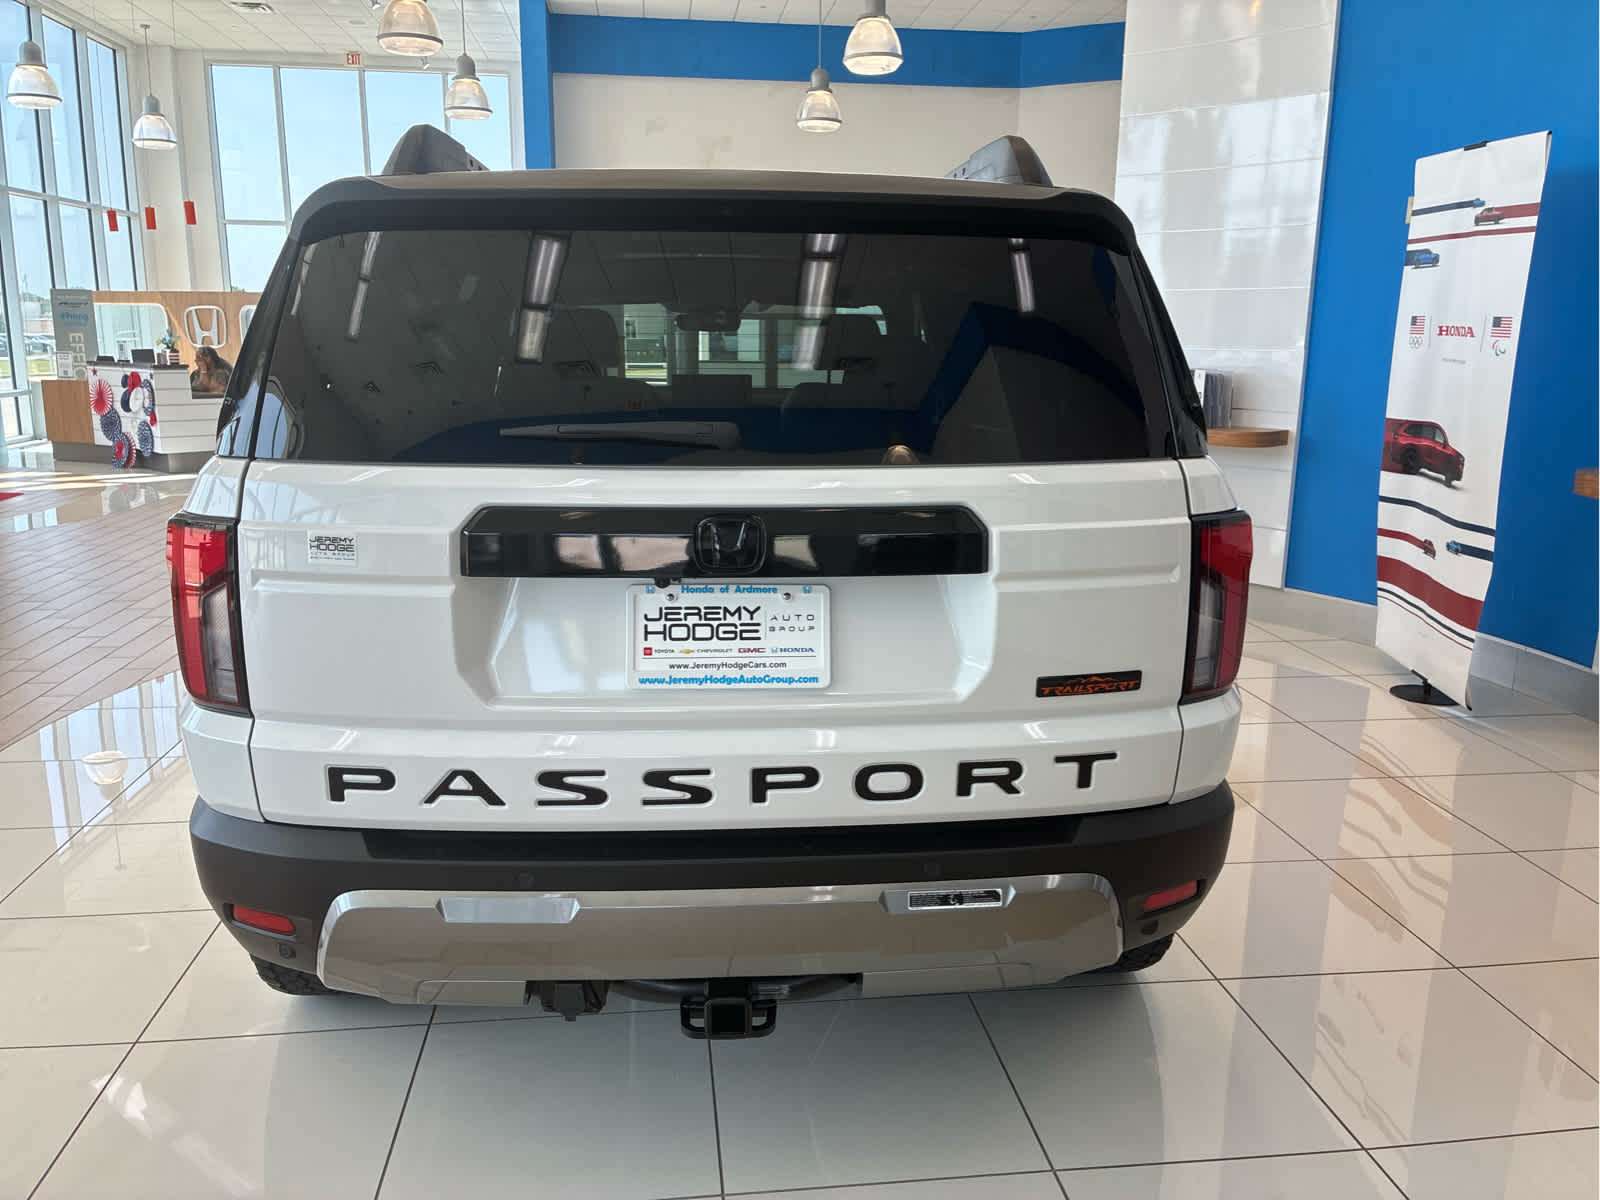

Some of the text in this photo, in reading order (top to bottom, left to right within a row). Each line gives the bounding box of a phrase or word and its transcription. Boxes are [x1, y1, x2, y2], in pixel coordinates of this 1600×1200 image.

[1437, 325, 1476, 338] HONDA
[309, 536, 354, 544] JEREMY
[309, 543, 355, 553] HODGE
[681, 585, 778, 594] Honda of Ardmore
[643, 606, 761, 622] JEREMY
[770, 614, 815, 622] AUTO
[643, 623, 762, 642] HODGE
[668, 661, 787, 671] www.JeremyHodgeCars.com
[638, 675, 819, 686] www.JeremyHodgeAutoGroup.com
[1040, 680, 1140, 696] TRAILSPORT
[328, 752, 1118, 808] PASSPORT
